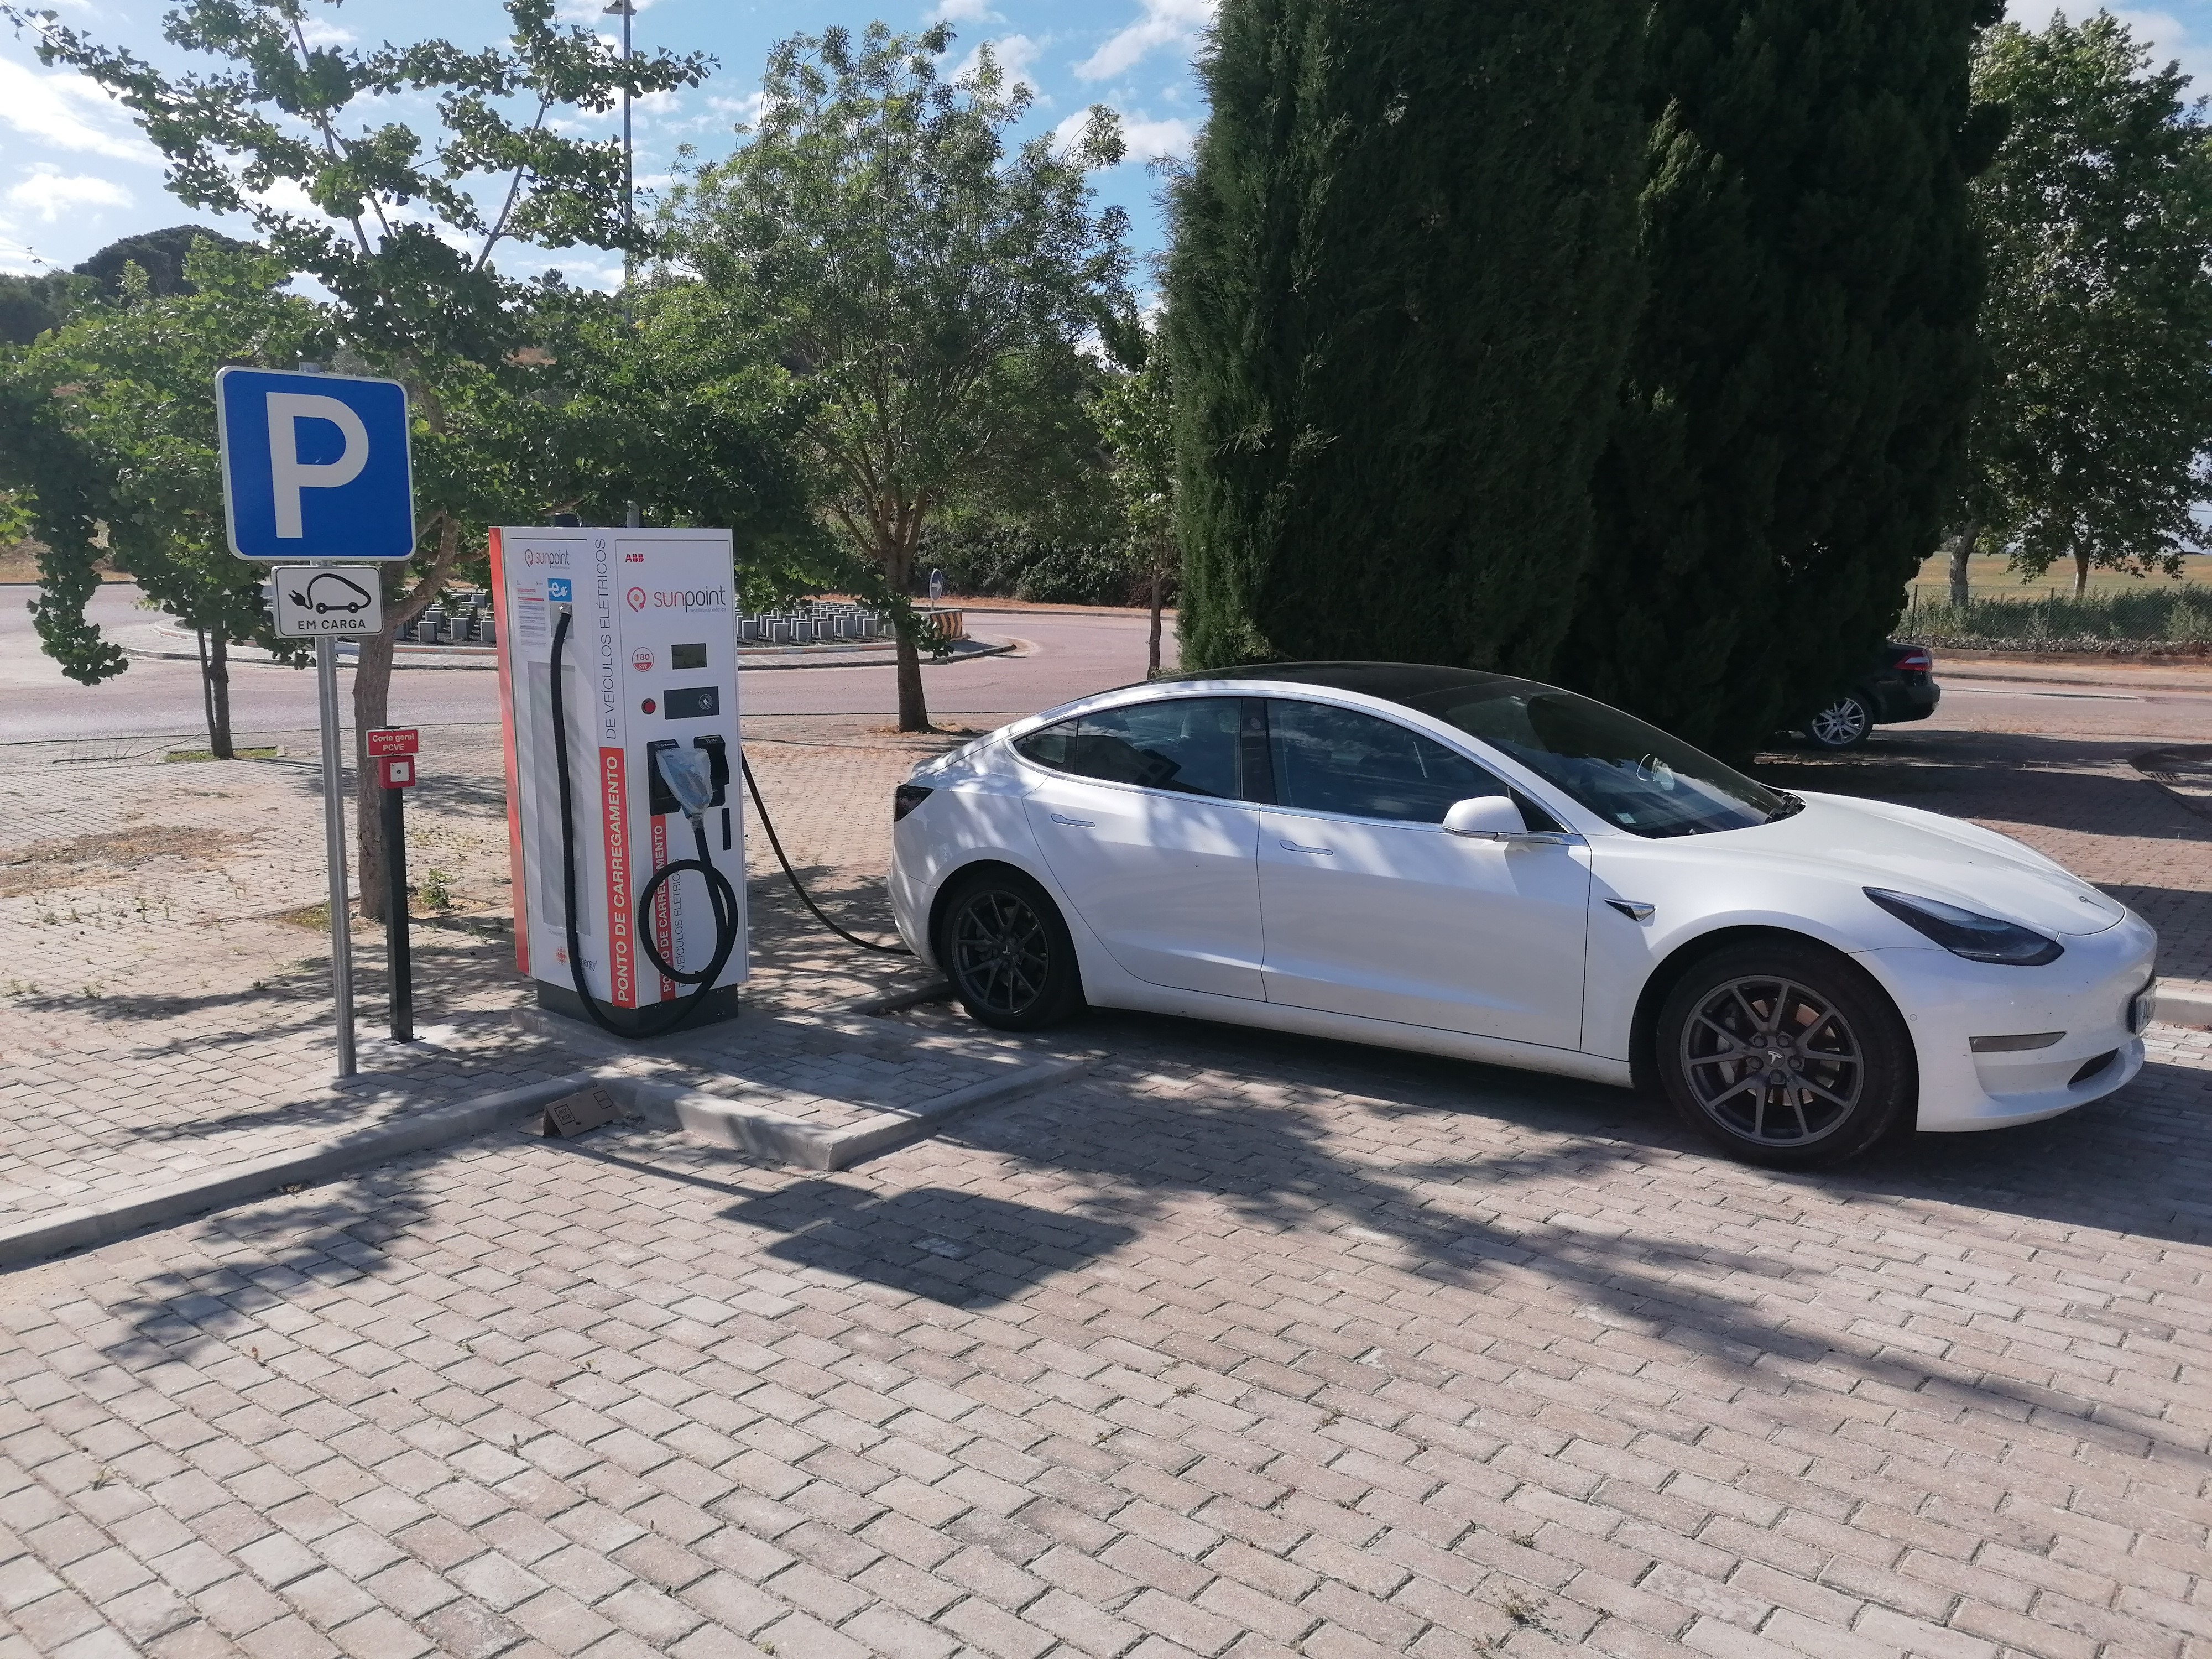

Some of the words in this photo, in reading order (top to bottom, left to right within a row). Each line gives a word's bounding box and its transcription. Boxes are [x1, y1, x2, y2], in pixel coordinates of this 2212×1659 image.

[266, 392, 369, 539] P
[535, 549, 570, 568] sunpoint
[625, 553, 644, 562] ABB
[595, 539, 610, 628] ELÉTRICOS
[654, 585, 726, 613] sunpoint
[298, 620, 316, 630] EM
[321, 619, 366, 629] CARGA
[601, 634, 615, 713] VEÍCULOS
[395, 733, 414, 743] geral
[606, 718, 616, 739] DE
[606, 756, 625, 907] CARREGAMENTO
[654, 825, 667, 928] CARREMENTO
[671, 858, 682, 916] ELÉTRIC
[614, 912, 626, 936] DE
[660, 930, 669, 947] DE
[675, 919, 685, 972] VEÍCULOS
[615, 941, 629, 1002] PONTO
[661, 950, 672, 992] POO
